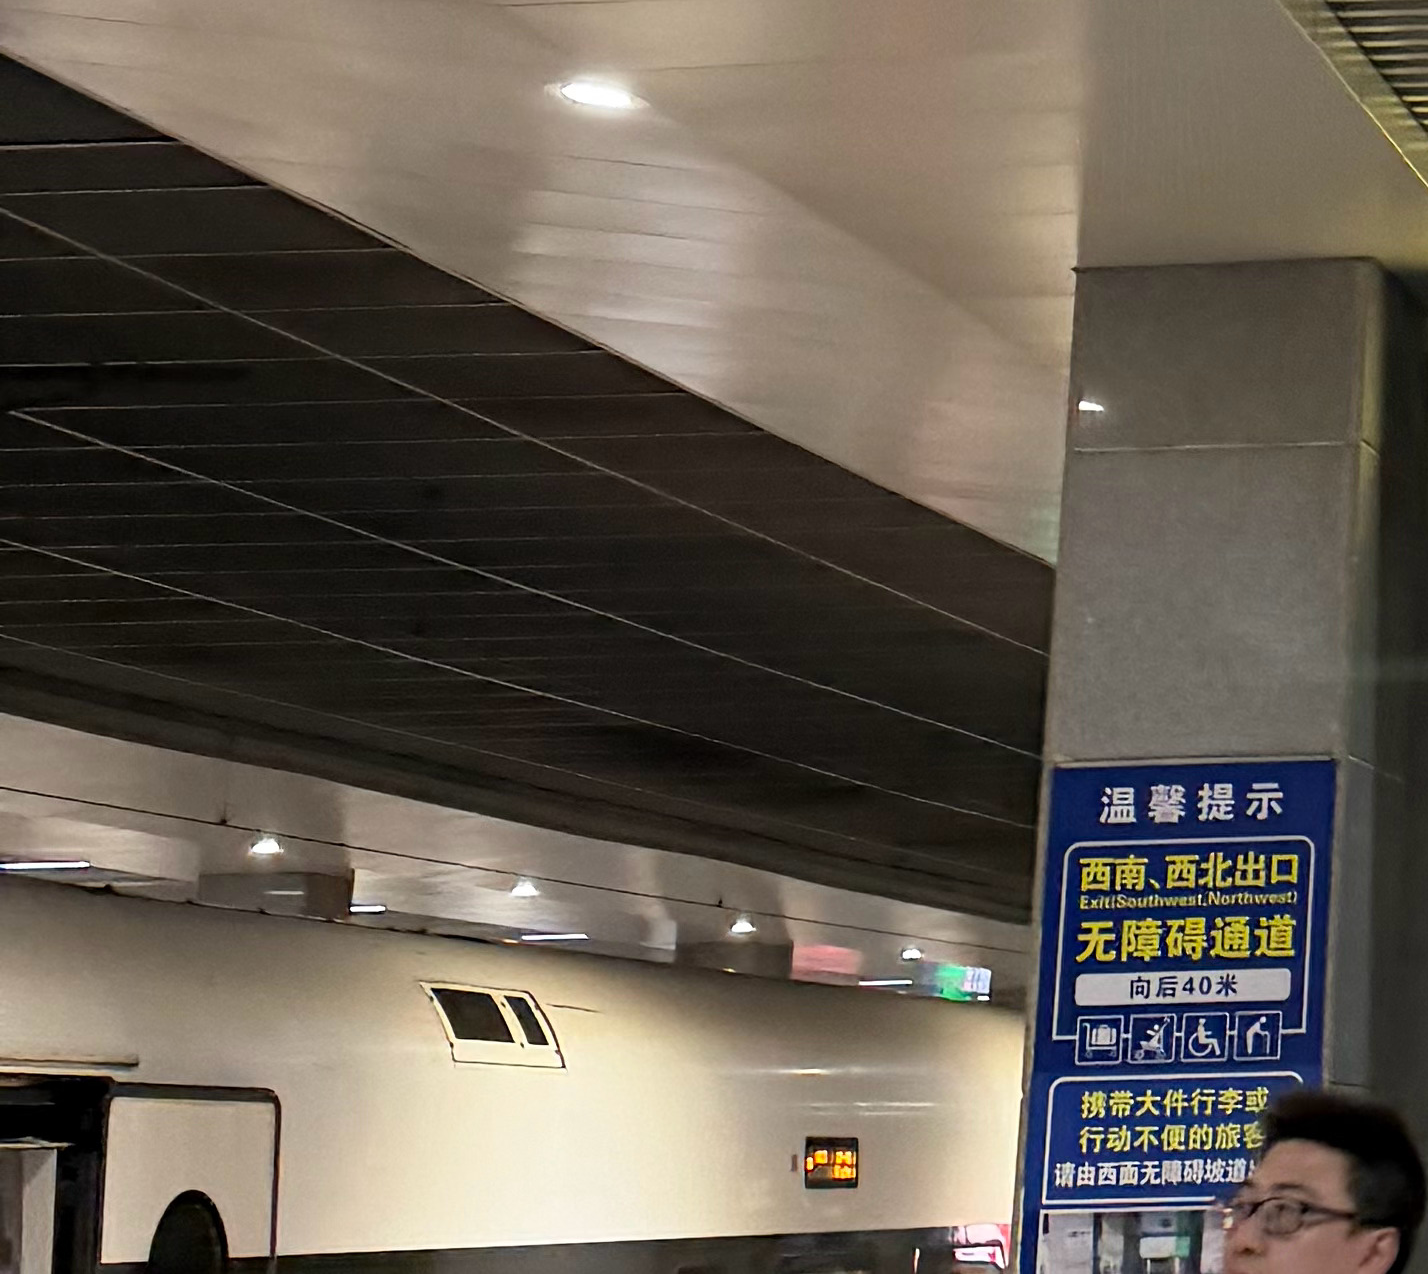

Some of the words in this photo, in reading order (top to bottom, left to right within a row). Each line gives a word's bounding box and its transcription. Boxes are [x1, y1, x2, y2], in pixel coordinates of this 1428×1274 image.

[1099, 782, 1284, 824] 温馨提示
[1078, 851, 1299, 892] 西南、西北出口
[1076, 915, 1297, 963] 无障碍通道
[1129, 973, 1238, 999] 向后40米
[1081, 1087, 1268, 1119] 携带大件行李或
